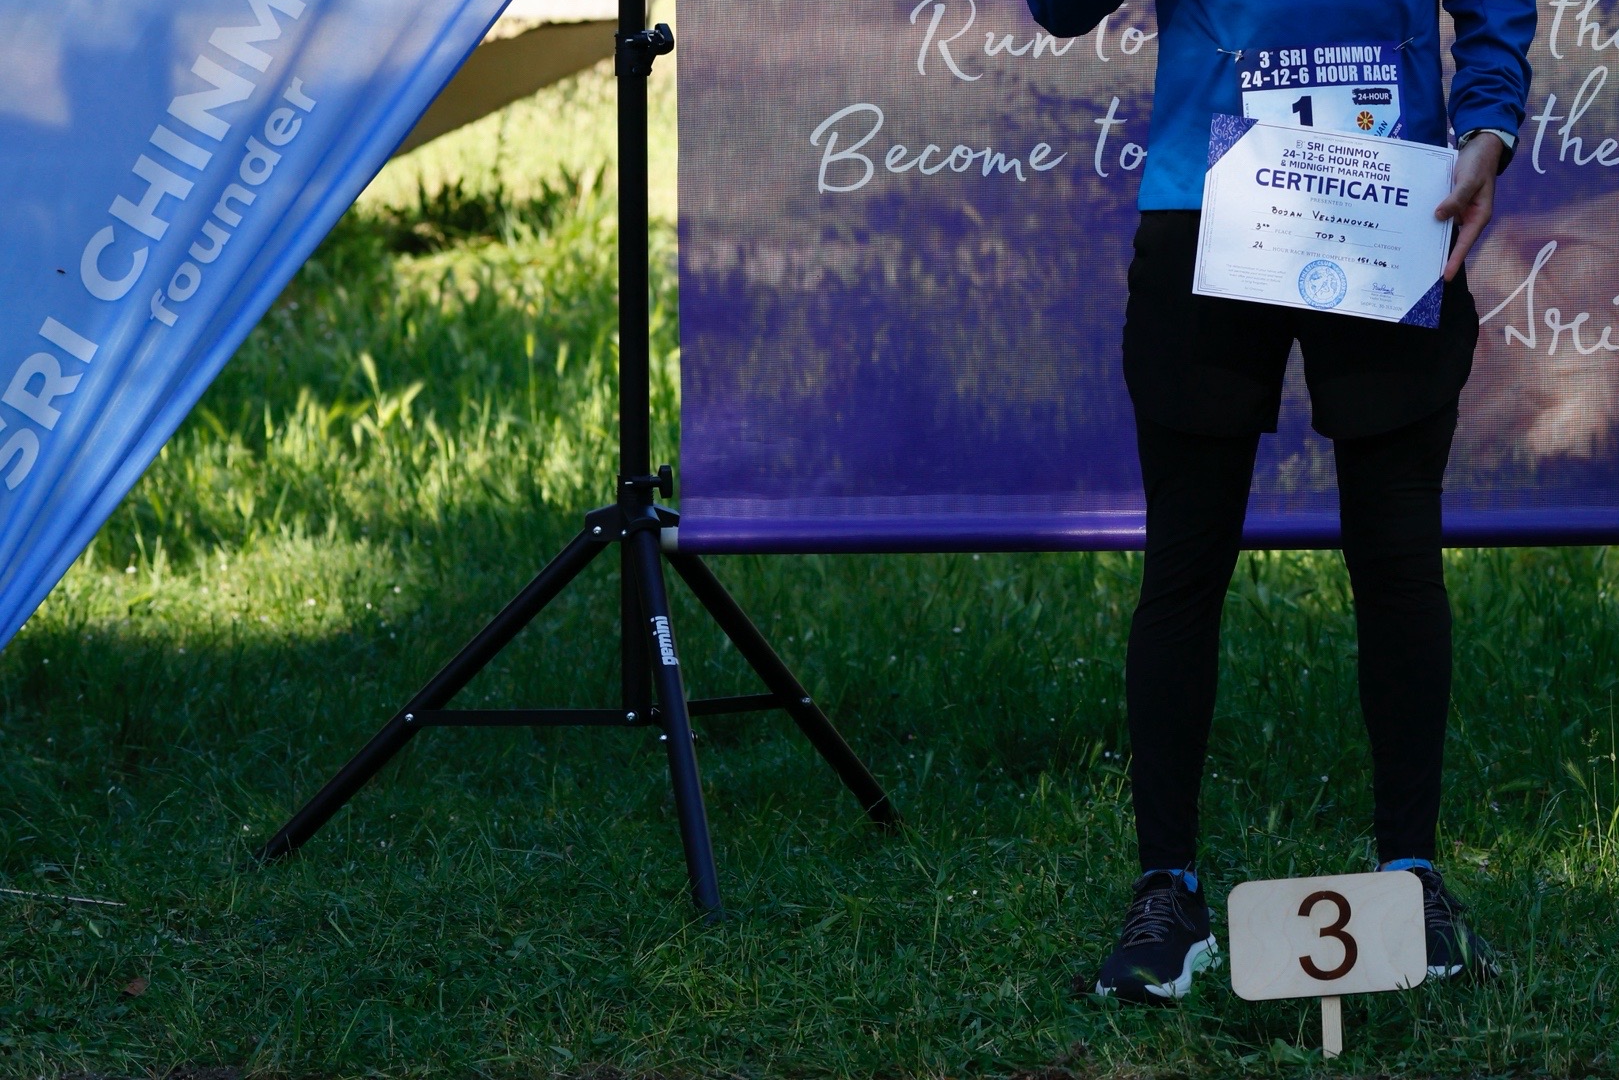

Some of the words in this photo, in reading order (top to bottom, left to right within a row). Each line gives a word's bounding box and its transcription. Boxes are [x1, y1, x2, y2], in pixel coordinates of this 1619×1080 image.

[1279, 49, 1307, 66] SRI
[1314, 46, 1382, 64] CHINMOY
[1241, 67, 1309, 89] 24-12-6
[1316, 66, 1358, 83] HOUR
[1364, 65, 1397, 81] RACE
[1357, 93, 1390, 101] 24-HOUR
[1292, 95, 1314, 127] 1
[1374, 120, 1388, 137] JAN
[809, 102, 1069, 194] Become
[1095, 96, 1148, 178] to
[1307, 141, 1324, 152] SRI
[1328, 144, 1379, 160] CHINMOY
[1280, 159, 1287, 167] &
[1289, 160, 1335, 174] MIDNIGHT
[1338, 167, 1391, 182] MARATHON
[1282, 149, 1325, 162] 24-12-6
[1328, 155, 1359, 168] HOUR
[1362, 160, 1391, 172] RACE
[1255, 168, 1409, 207] CERTIFICATE
[149, 76, 319, 329] founder
[1310, 197, 1344, 207] PRESENTED
[1252, 241, 1264, 249] 24
[1315, 231, 1334, 240] TOP
[1338, 235, 1346, 243] 3
[0, 316, 99, 491] SRI
[650, 615, 680, 666] gemini
[1297, 890, 1358, 981] 3
